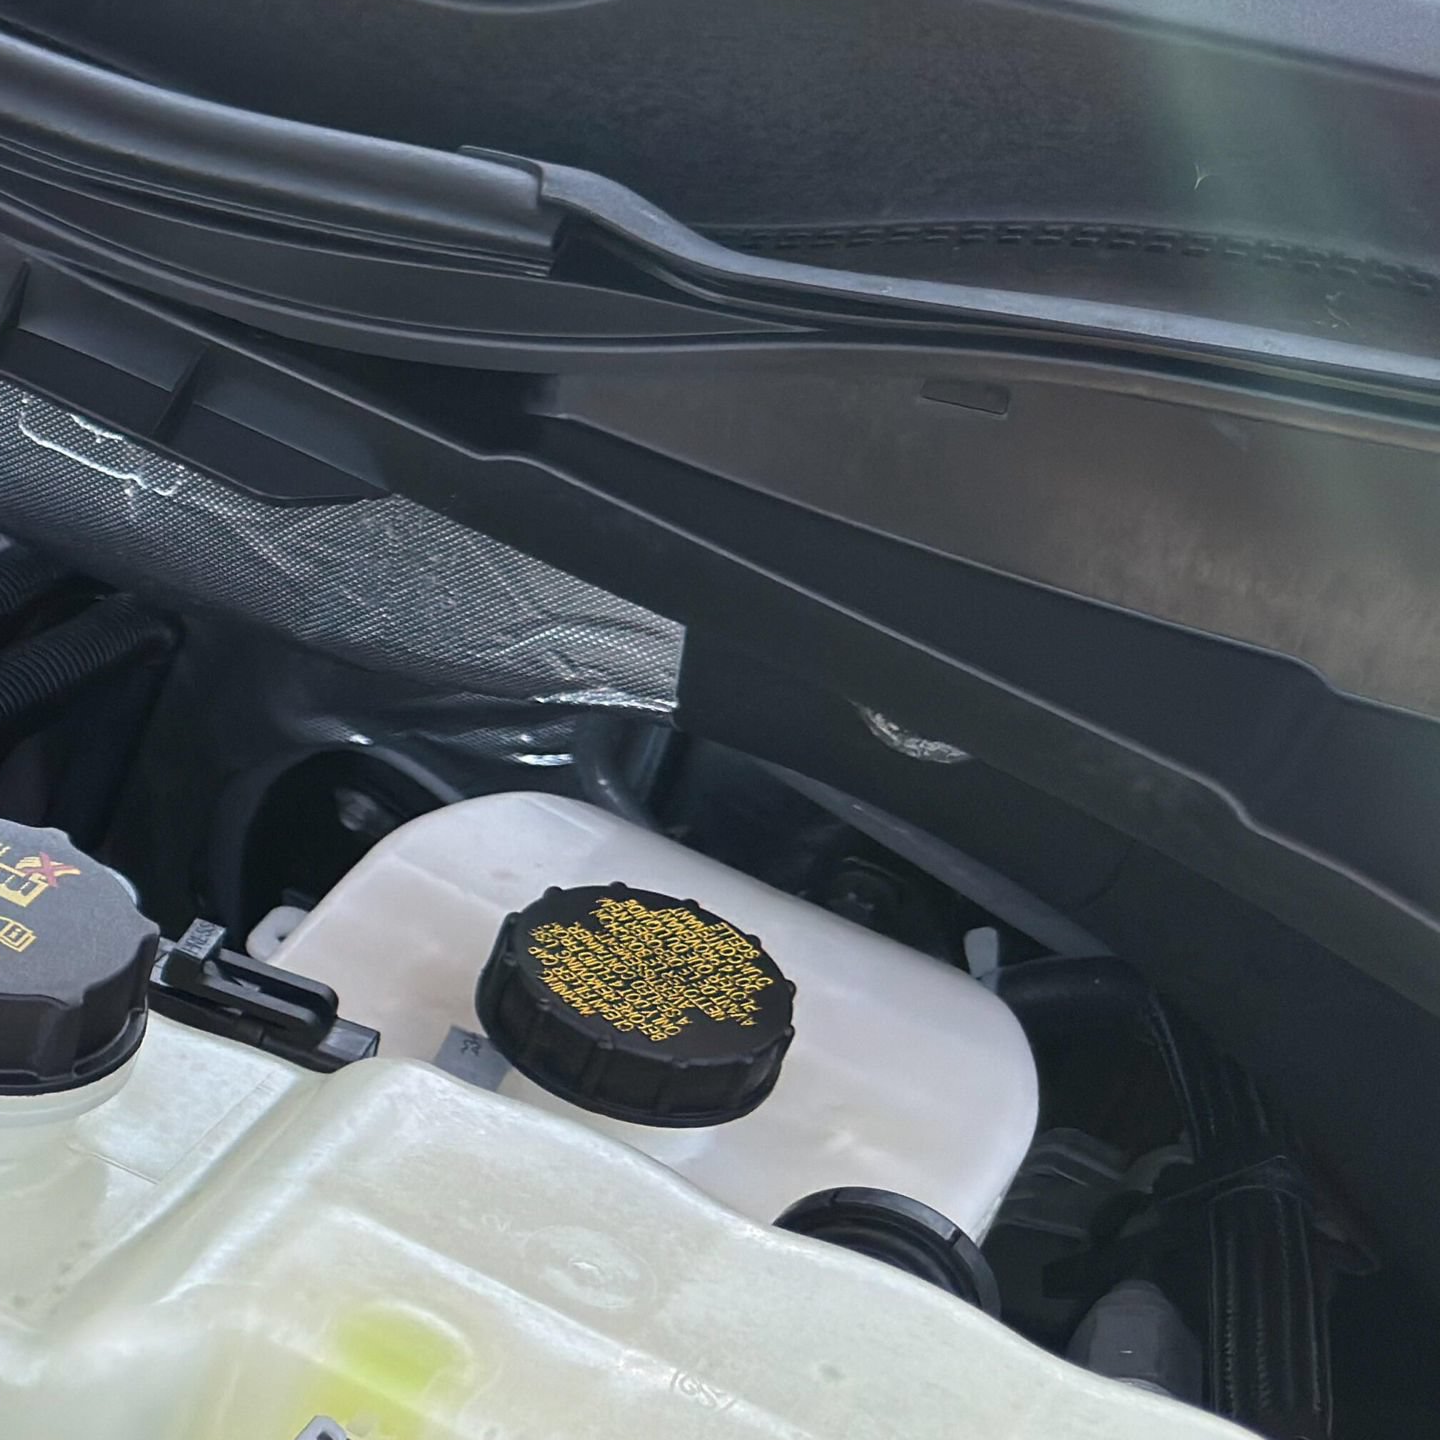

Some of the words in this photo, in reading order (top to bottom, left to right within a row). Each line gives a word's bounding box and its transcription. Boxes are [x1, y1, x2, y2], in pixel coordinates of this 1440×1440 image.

[622, 900, 670, 934] LIQUIDE
[528, 946, 558, 964] CAP
[645, 955, 670, 971] LE
[683, 953, 713, 971] QUE
[553, 968, 595, 996] FILLER
[676, 964, 701, 980] LE
[633, 982, 679, 1015] SEALED
[692, 978, 718, 994] DE
[590, 1000, 633, 1030] CLEAN
[616, 1003, 665, 1039] BEFORE
[644, 1010, 680, 1033] ONLY
[712, 995, 755, 1024] AVANT
